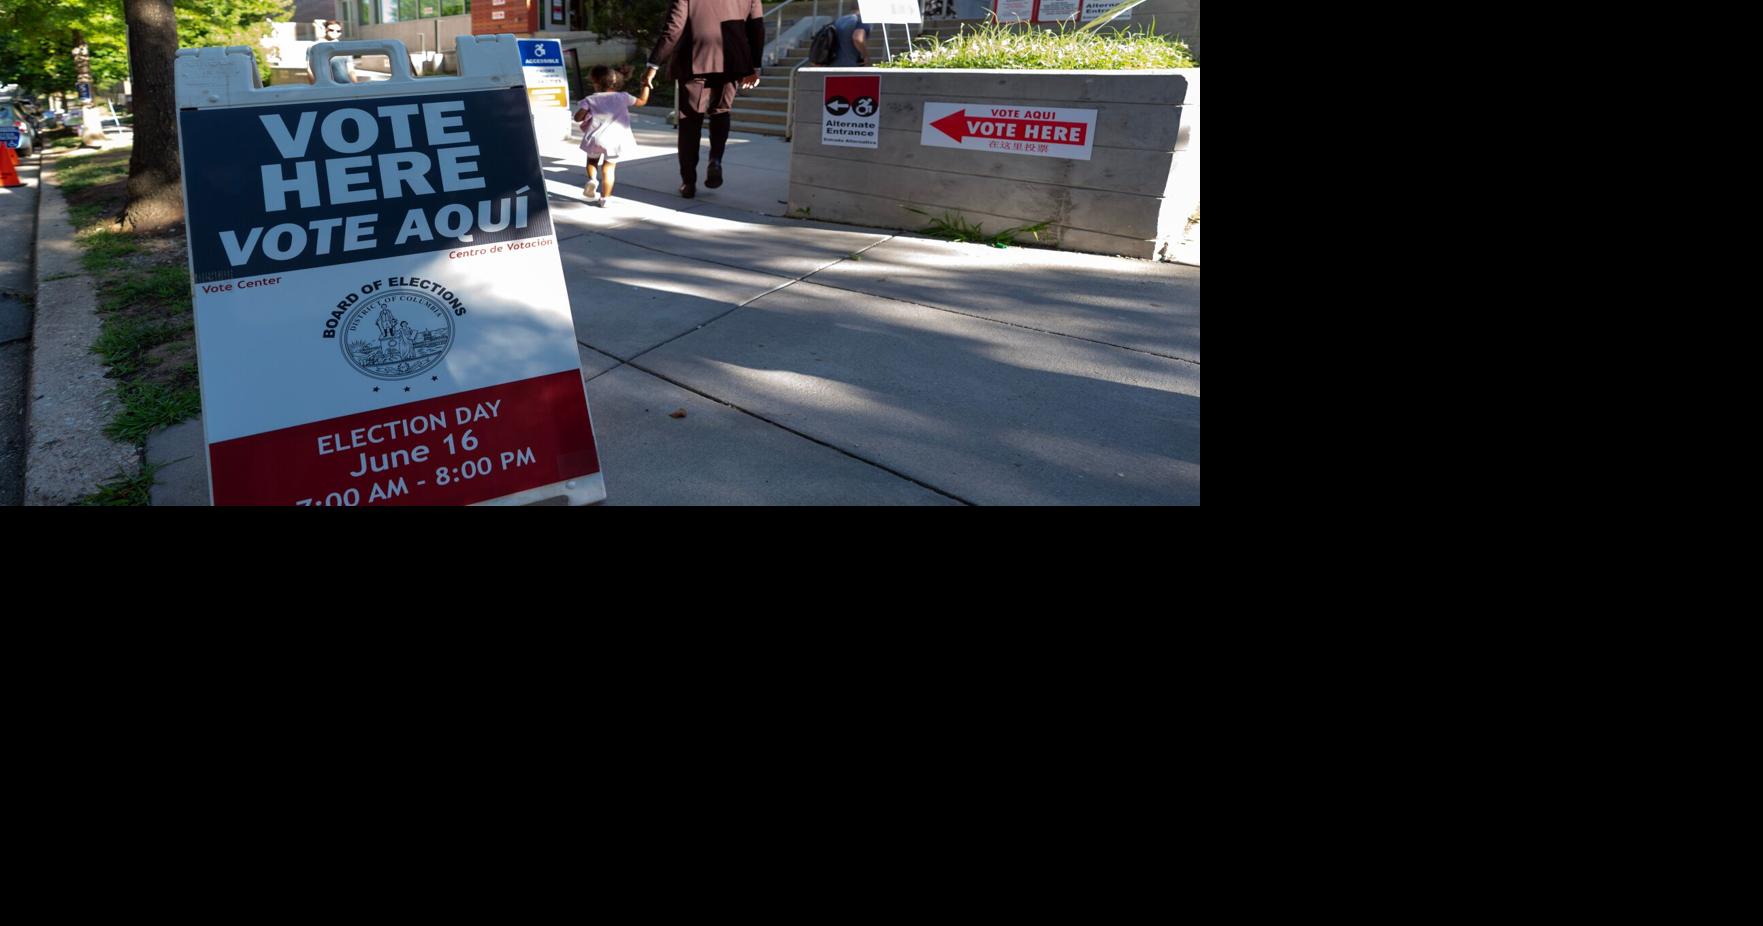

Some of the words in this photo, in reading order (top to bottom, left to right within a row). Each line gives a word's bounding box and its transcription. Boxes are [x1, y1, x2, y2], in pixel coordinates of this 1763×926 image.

[259, 100, 471, 159] VOTE
[826, 120, 876, 129] Alternate
[826, 127, 874, 137] Entrance
[966, 120, 1018, 138] VOTE
[1024, 123, 1082, 142] HERE
[991, 109, 1019, 118] VOTE
[1024, 110, 1056, 120] AQUI
[260, 145, 486, 213] HERE
[218, 213, 379, 267] VOTE
[394, 185, 531, 243] AQUÍ
[449, 247, 487, 260] Centro
[490, 244, 503, 254] de
[507, 237, 553, 252] Votación
[202, 281, 233, 295] Vote
[237, 275, 282, 289] Center
[323, 292, 359, 339] BOARD
[361, 280, 382, 295] OF
[388, 276, 467, 317] ELECTIONS
[350, 299, 383, 332] DISTRICT
[384, 295, 397, 304] OF
[399, 295, 443, 318] COLUMBIA
[316, 410, 447, 456] ELECTION
[455, 399, 502, 426] DAY
[350, 444, 430, 477] June
[443, 429, 479, 455] 16
[368, 476, 409, 503] AM
[435, 456, 493, 486] 8:00
[500, 446, 536, 471] PM
